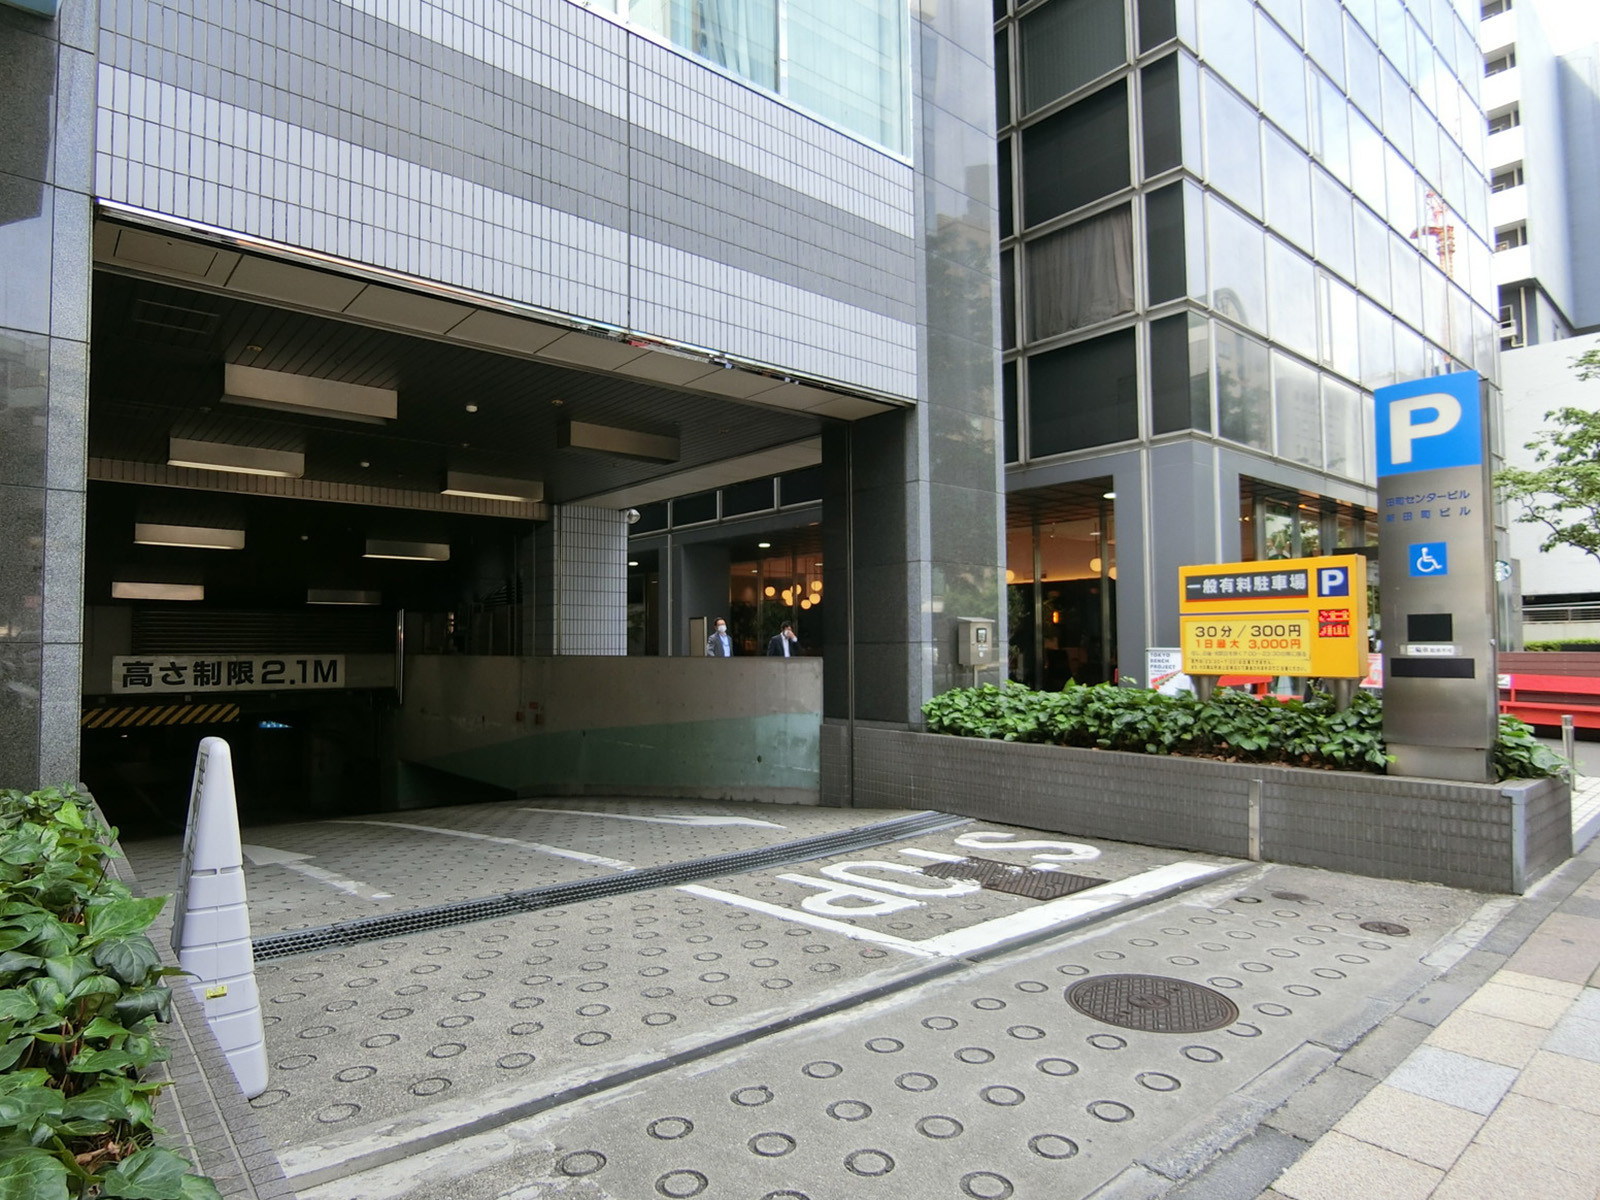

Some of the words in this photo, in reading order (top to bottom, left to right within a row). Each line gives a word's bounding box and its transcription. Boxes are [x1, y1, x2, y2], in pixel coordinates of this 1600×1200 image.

[1390, 392, 1462, 465] P
[1186, 573, 1307, 594] 一般有料駐車場
[1321, 569, 1344, 595] P
[1248, 638, 1301, 649] 3,000円
